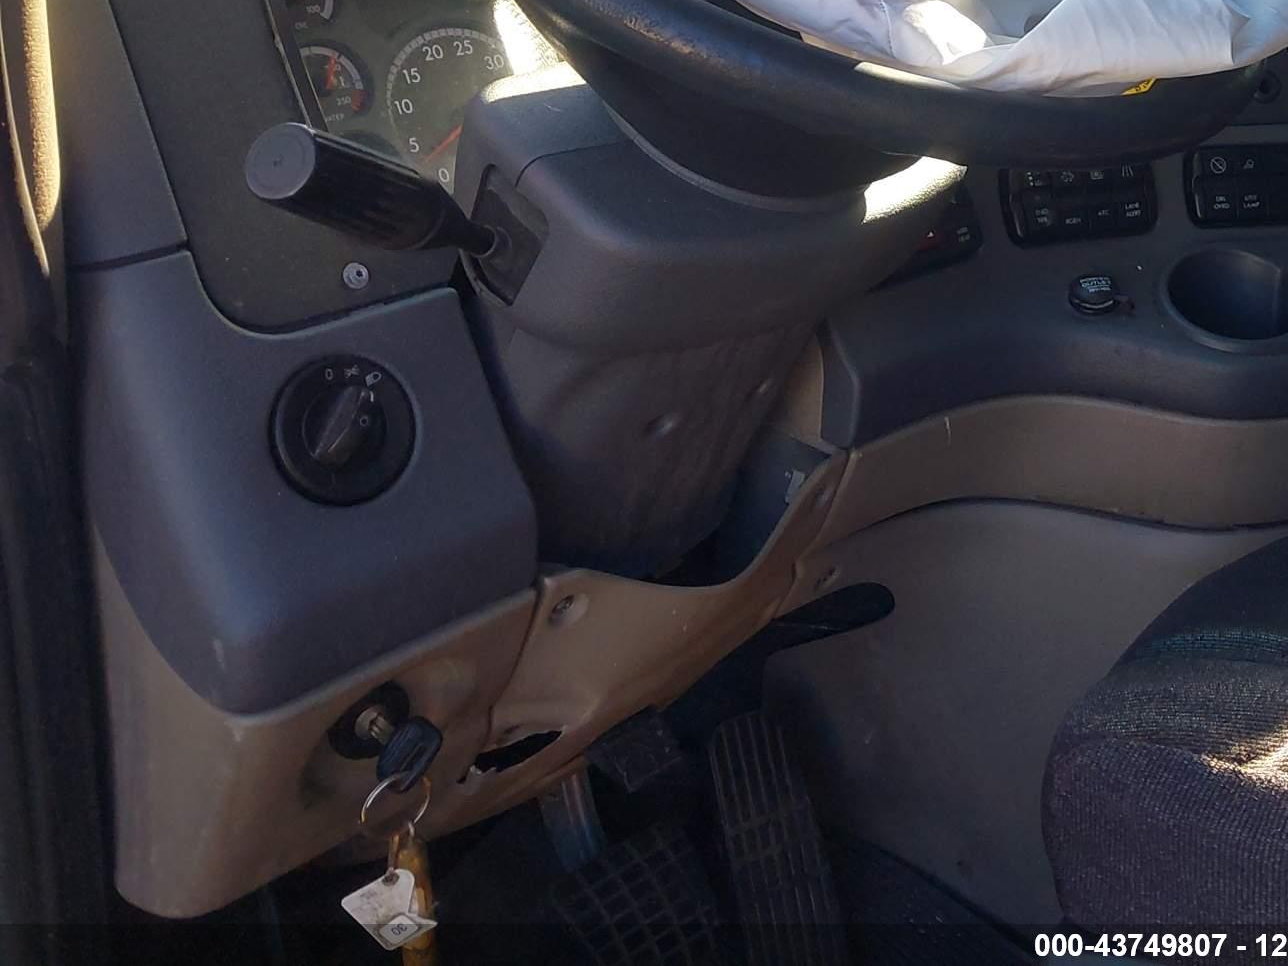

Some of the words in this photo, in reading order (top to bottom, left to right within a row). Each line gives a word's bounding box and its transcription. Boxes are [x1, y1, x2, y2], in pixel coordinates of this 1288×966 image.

[422, 43, 444, 62] 20
[452, 38, 473, 56] 25
[483, 53, 505, 71] 30
[402, 68, 421, 84] 15
[394, 98, 413, 115] 10
[409, 136, 419, 153] 5
[439, 166, 449, 183] 0
